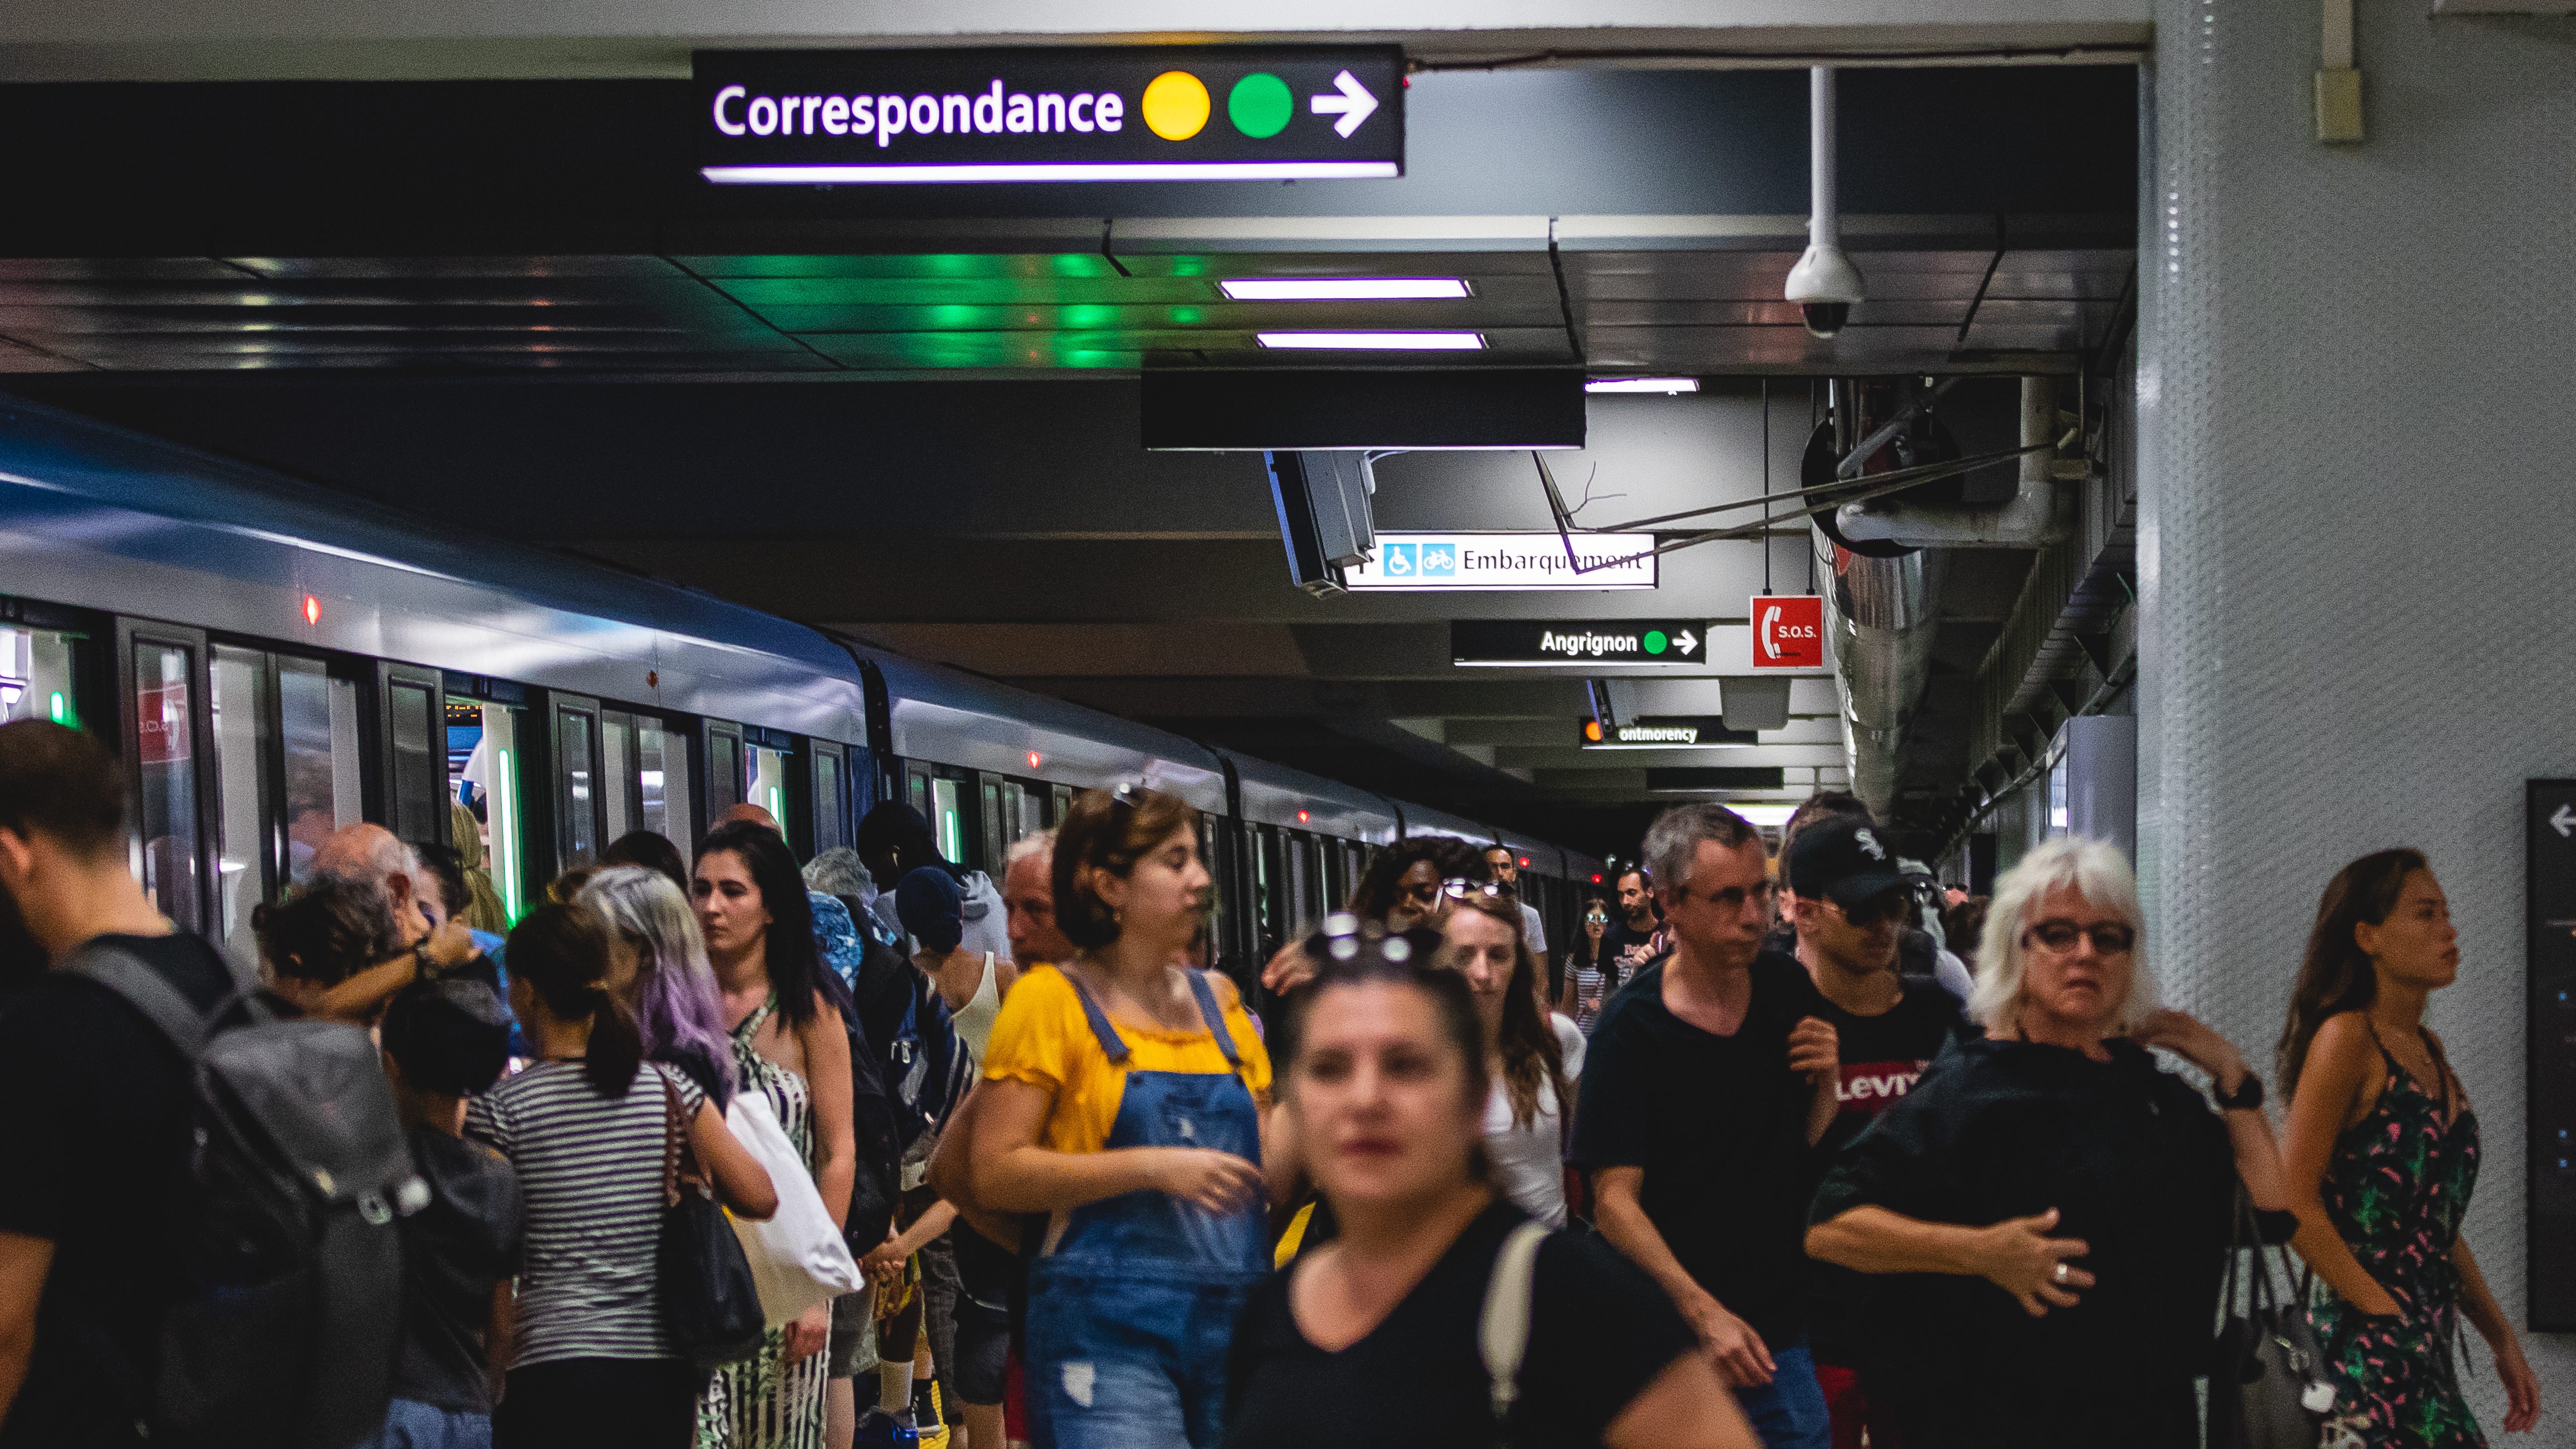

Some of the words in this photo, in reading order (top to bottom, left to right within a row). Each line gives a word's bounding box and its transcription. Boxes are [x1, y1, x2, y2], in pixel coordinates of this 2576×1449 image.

[714, 80, 1123, 147] Correspondance
[1778, 625, 1817, 638] S.O.S.
[1541, 631, 1637, 656] Angrignon
[1619, 727, 1697, 744] ontmorency
